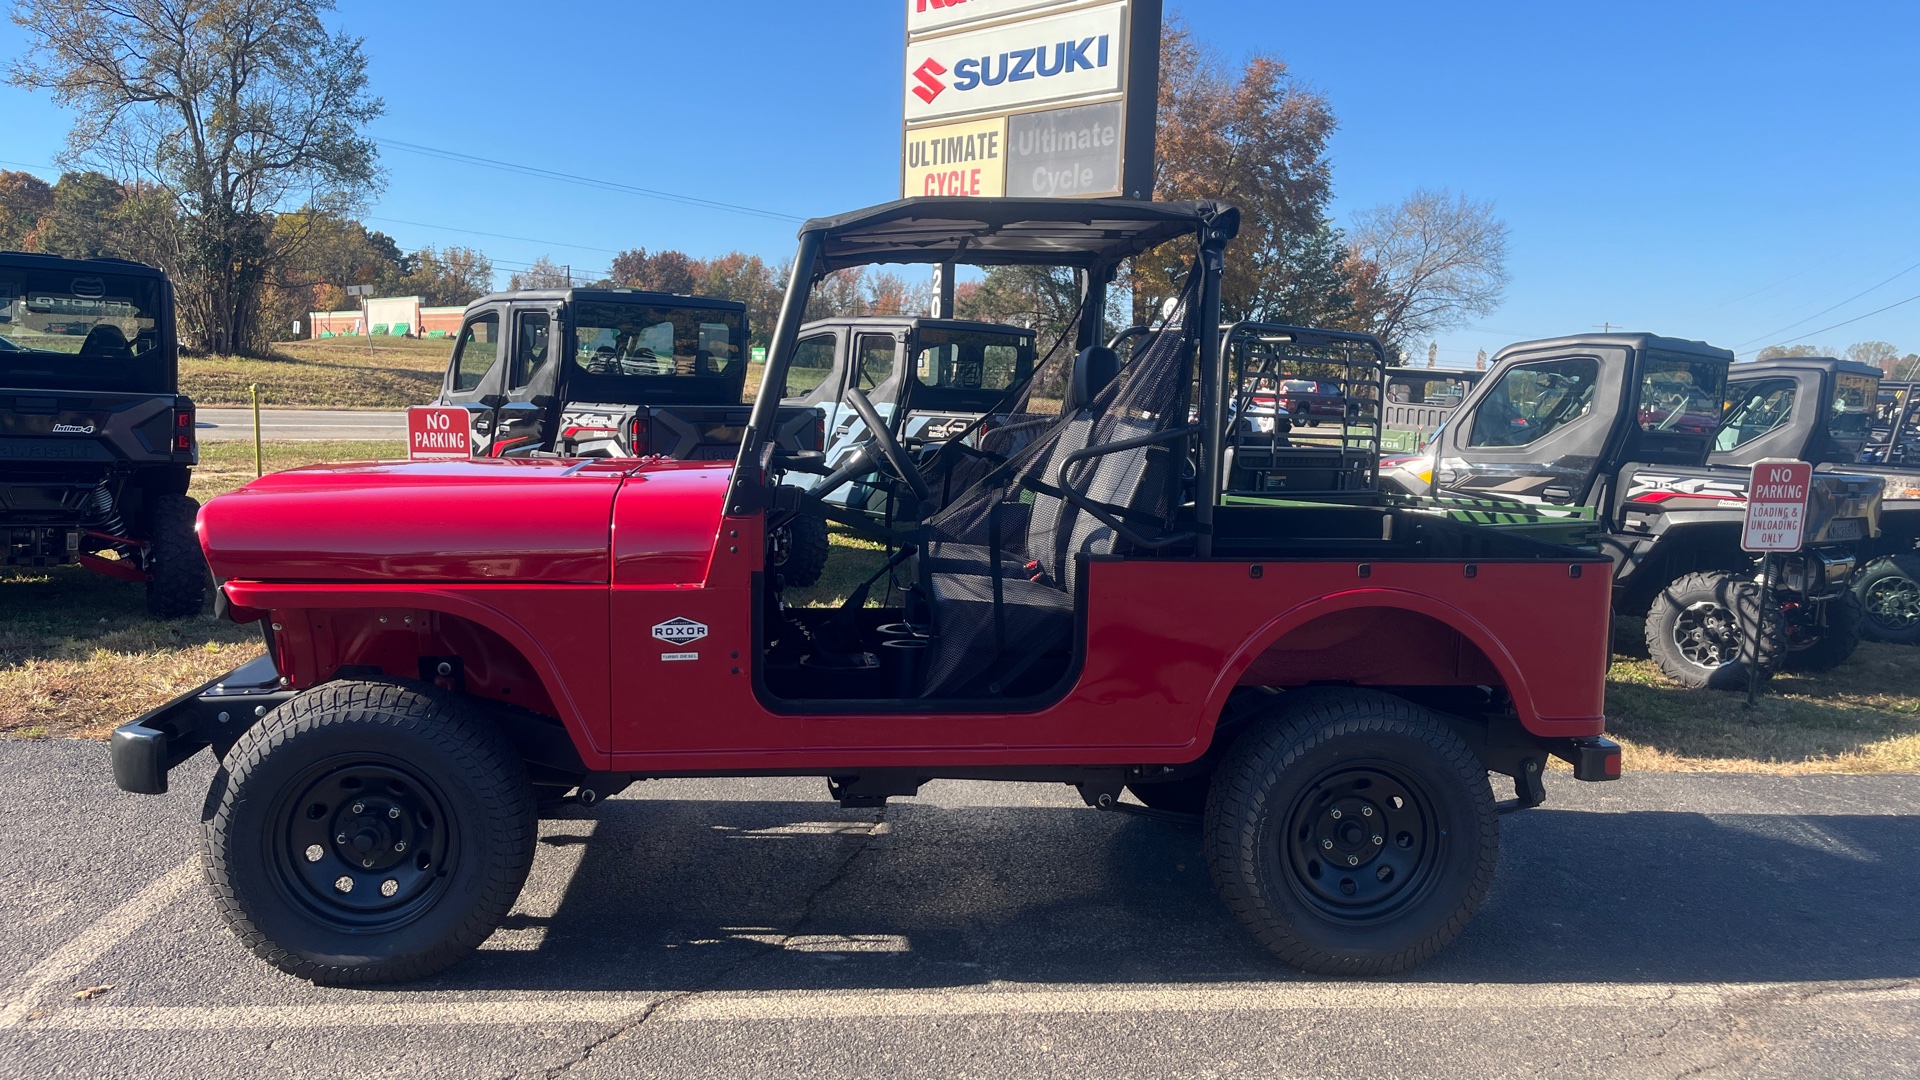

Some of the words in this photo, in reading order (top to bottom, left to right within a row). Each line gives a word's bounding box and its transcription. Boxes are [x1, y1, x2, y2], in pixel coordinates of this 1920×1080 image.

[953, 34, 1109, 91] SUZUKI
[1018, 121, 1115, 156] Ultimate
[908, 130, 999, 168] ULTIMATE
[924, 168, 981, 197] CYCLE
[1032, 162, 1094, 196] Cycle
[426, 413, 450, 430] NO
[415, 432, 465, 448] PARKING
[1769, 468, 1792, 483] NO
[1645, 481, 1692, 491] RIDGE
[1755, 484, 1803, 499] PARKING
[1753, 507, 1789, 518] LOADING
[1791, 507, 1798, 518] &
[1751, 520, 1798, 530] UNLOADING
[1761, 533, 1784, 543] ONLY
[655, 627, 706, 636] ROXOR
